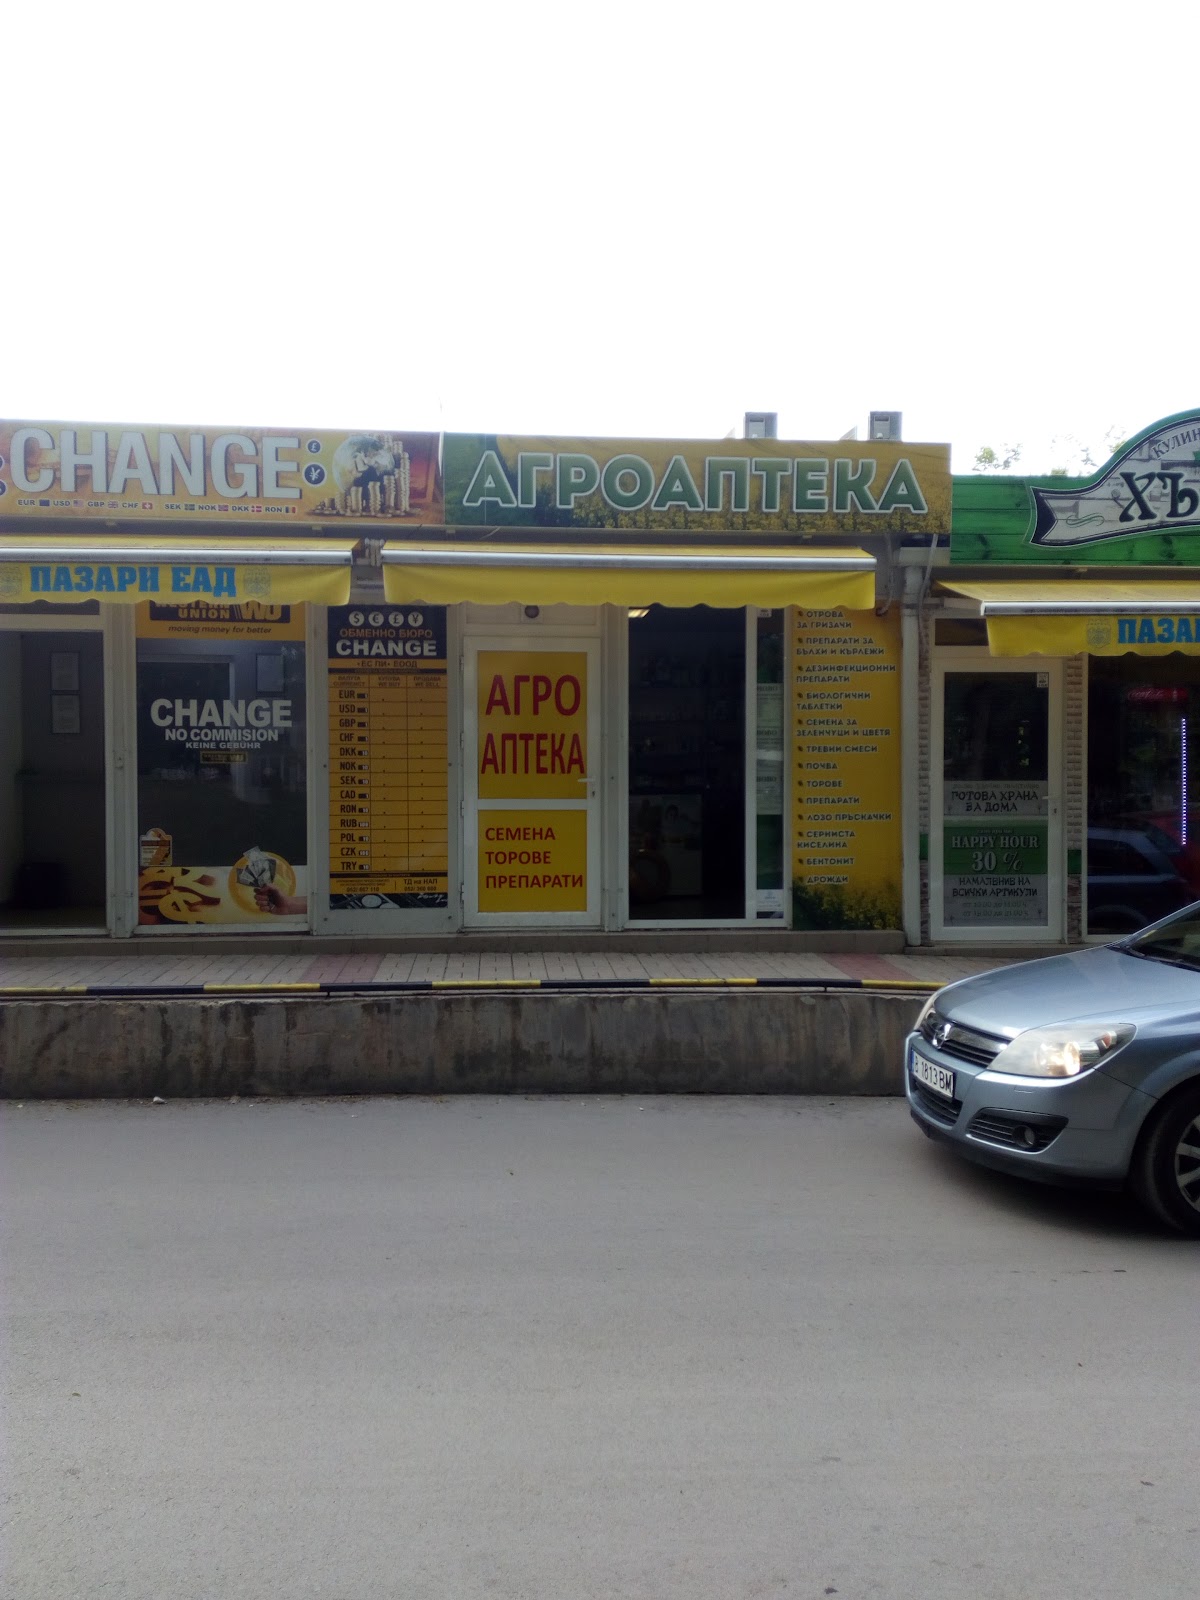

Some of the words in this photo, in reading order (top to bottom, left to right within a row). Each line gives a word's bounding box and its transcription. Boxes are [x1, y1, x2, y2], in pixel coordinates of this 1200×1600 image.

[10, 427, 302, 499] CHANGE
[463, 450, 928, 514] АГРОАПТЕКА
[1118, 471, 1199, 523] ХЪ
[30, 566, 159, 592] ПАЗАРИ
[171, 567, 236, 597] ЕАД
[178, 608, 230, 619] UNION
[806, 610, 844, 618] ОТРОВА
[811, 621, 852, 629] ГРИЗАЧИ
[168, 625, 200, 634] moving
[202, 626, 230, 635] money
[232, 625, 245, 633] for
[246, 626, 272, 634] better
[339, 628, 396, 638] ОБМЕННО
[399, 629, 433, 639] БЮРО
[1118, 618, 1200, 644] ПАЗА
[806, 637, 860, 645] ПРЕПАРАТИ
[336, 638, 438, 656] CHANGE
[394, 660, 418, 668] ЕООД
[339, 690, 356, 699] EUR
[485, 674, 581, 716] АГРО
[806, 692, 871, 700] БИОЛОГИЧНИ
[150, 698, 293, 728] CHANGE
[339, 704, 356, 713] USD
[339, 718, 356, 727] GBP
[165, 729, 187, 740] NO
[190, 729, 279, 741] COMMISION
[339, 733, 354, 742] CHF
[220, 741, 260, 749] GEBÜHR
[807, 745, 842, 753] ТРЕВНИ
[339, 747, 356, 756] DKK
[481, 733, 585, 774] АПТЕКА
[340, 762, 356, 771] NOK
[340, 776, 356, 785] SEK
[806, 780, 842, 788] ТОРОВЕ
[340, 790, 356, 799] CAD
[951, 790, 997, 801] ГОТОВА
[1000, 790, 1039, 801] ХРАНА
[340, 804, 356, 813] RON
[984, 802, 1018, 813] ДОМА
[340, 819, 357, 828] RUB
[340, 833, 356, 842] POL
[485, 826, 556, 841] СЕМЕНА
[797, 841, 848, 849] КИСЕЛИНА
[952, 836, 998, 849] HAPPY
[1000, 836, 1040, 849] HOUR
[340, 847, 356, 856] CZK
[485, 851, 552, 865] ТОРОВЕ
[972, 851, 997, 872] 30
[1003, 851, 1024, 871] %
[341, 861, 357, 870] TRY
[486, 874, 583, 889] ПРЕПАРАТИ
[807, 876, 848, 884] ДРОЖДИ
[1018, 877, 1031, 886] НА
[953, 888, 988, 897] ВСИЧКИ
[990, 888, 1038, 897] АРТИКУЛИ
